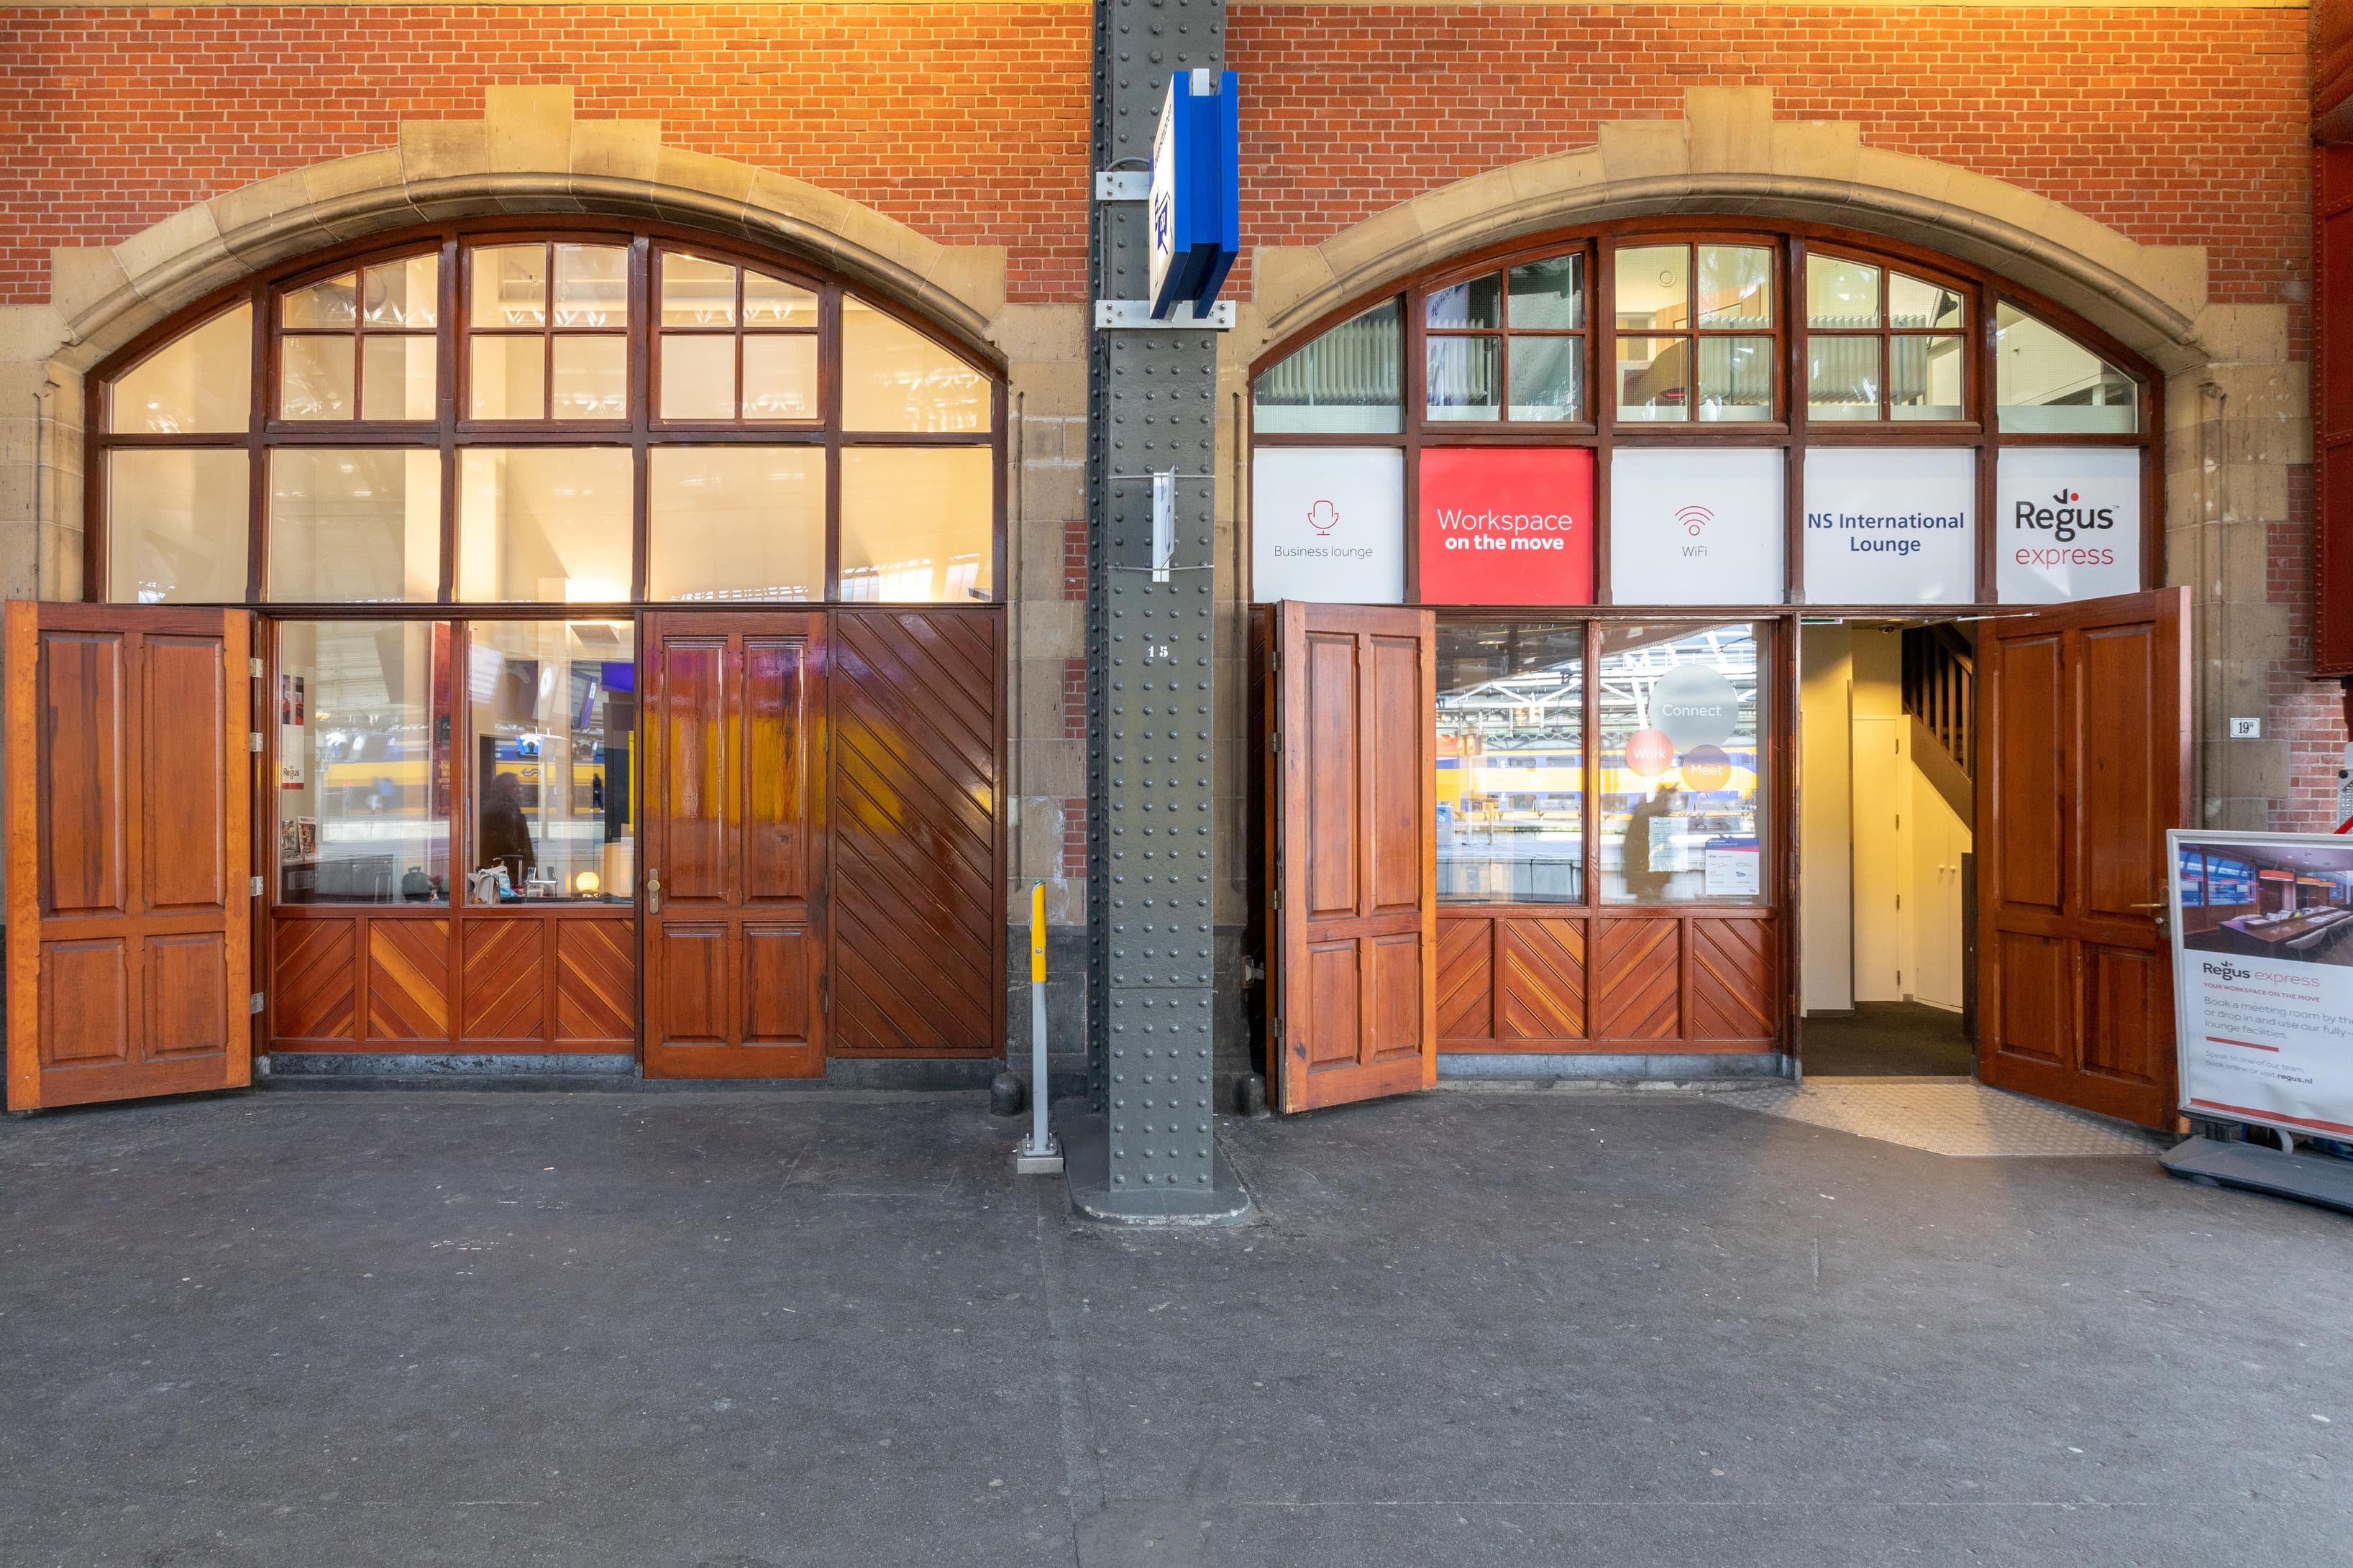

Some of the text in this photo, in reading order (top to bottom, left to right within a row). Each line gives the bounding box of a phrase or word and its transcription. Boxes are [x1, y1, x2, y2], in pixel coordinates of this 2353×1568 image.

[1437, 509, 1573, 536] Workspace
[1808, 512, 1964, 528] NS International
[2016, 500, 2114, 543] Regus
[1445, 533, 1564, 550] on the move
[1850, 536, 1921, 556] Lounge
[1274, 546, 1373, 559] Business lounge
[1681, 546, 1707, 557] WiFi
[2015, 549, 2114, 570] express
[1662, 704, 1722, 716] Connect
[1633, 748, 1666, 760] Work
[283, 766, 300, 780] Regus
[1691, 764, 1723, 776] Meet
[2203, 962, 2320, 987] Regus express
[2223, 985, 2267, 996] WORKSPACE
[2298, 994, 2321, 1003] MOVE
[2204, 996, 2230, 1007] Book
[2241, 1004, 2287, 1017] meeting
[2289, 1010, 2321, 1020] room
[2323, 1013, 2336, 1024] by
[2339, 1016, 2353, 1024] th
[2205, 1019, 2240, 1033] lounge
[2217, 1011, 2242, 1022] drop
[2254, 1017, 2276, 1026] and
[2277, 1020, 2299, 1030] use
[2205, 1050, 2228, 1060] Speak
[2277, 1073, 2313, 1084] regus.nl
